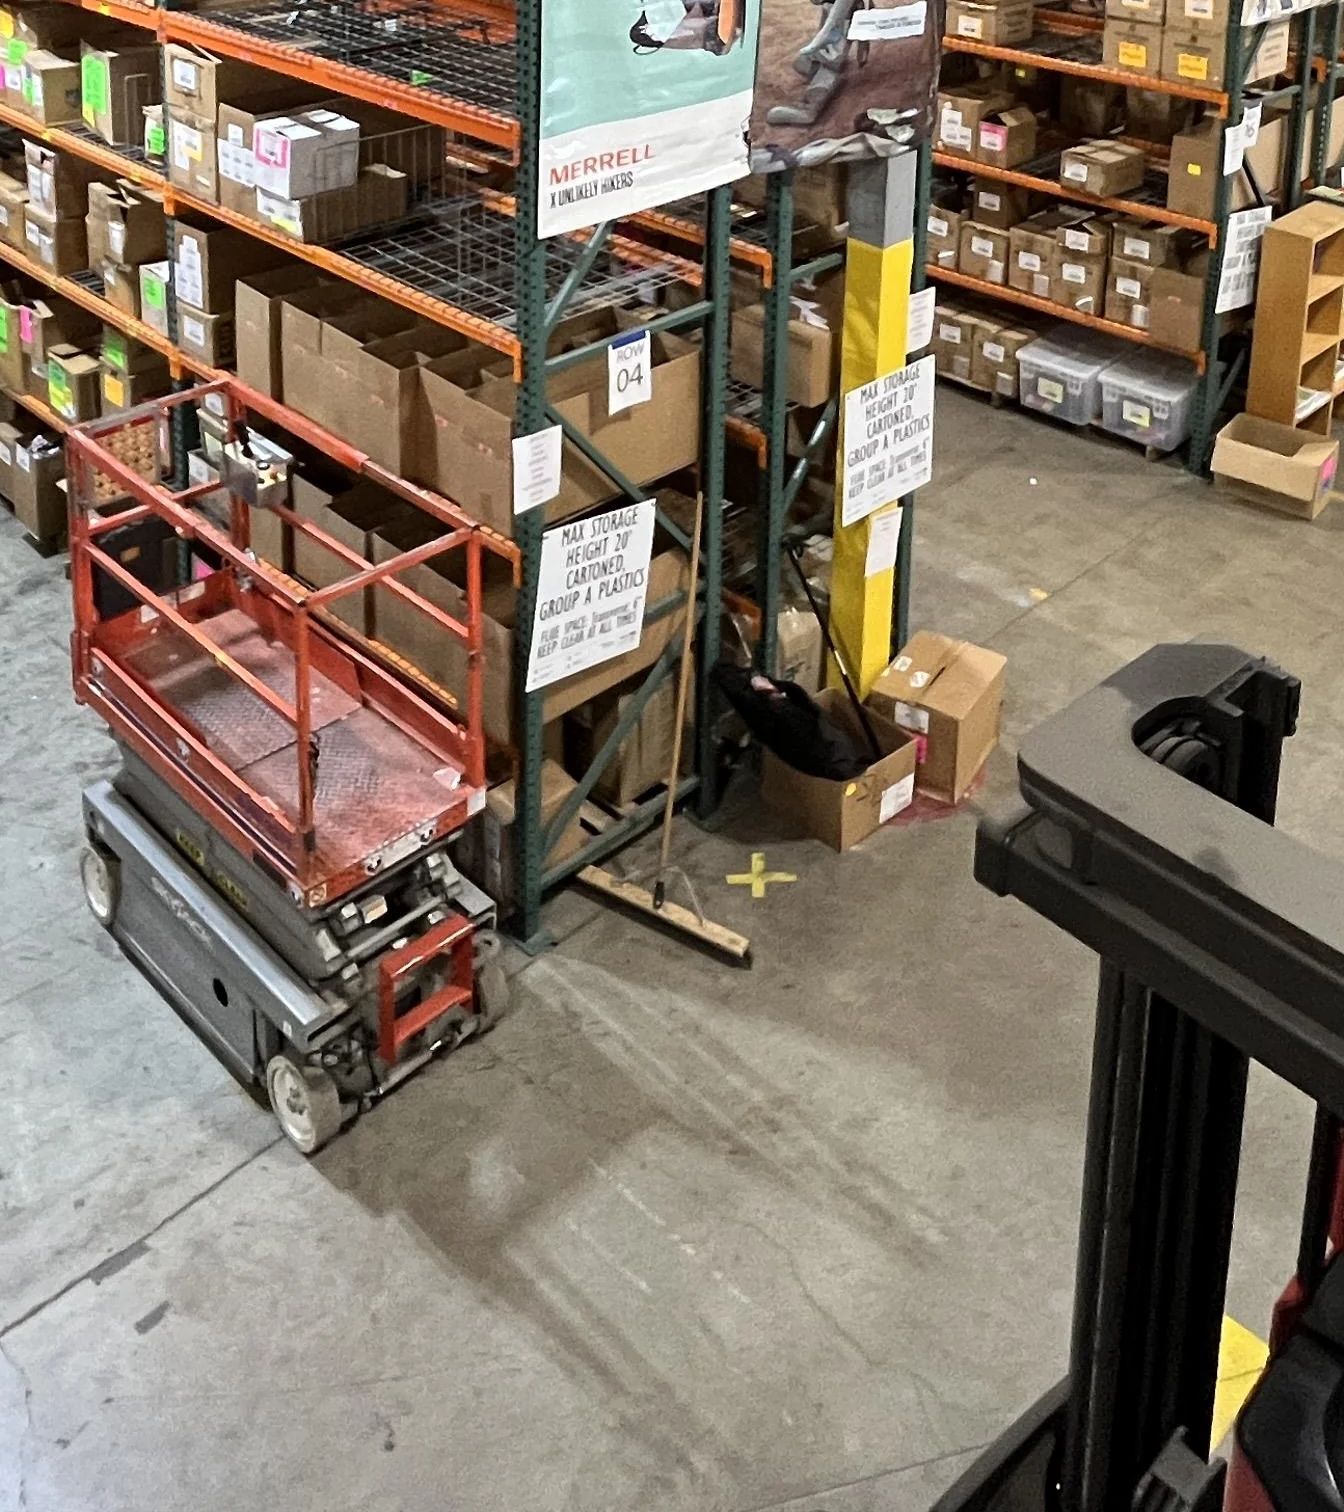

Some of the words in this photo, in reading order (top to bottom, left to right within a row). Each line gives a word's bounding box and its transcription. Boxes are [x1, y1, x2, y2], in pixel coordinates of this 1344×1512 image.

[550, 144, 656, 185] MERRELL
[617, 342, 645, 363] ROW
[617, 363, 643, 392] 04
[860, 382, 878, 404] MAX
[884, 362, 920, 393] STORAGE
[866, 391, 898, 421] HEIGHT
[848, 439, 879, 467] GROUP
[883, 434, 888, 450] A
[894, 413, 930, 444] PLASTICS
[562, 524, 584, 547] MAX
[591, 507, 638, 538] STORAGE
[566, 537, 609, 568] HEIGHT
[540, 591, 580, 621] GROUP
[584, 586, 591, 604] A
[598, 568, 644, 600] PLASTICS
